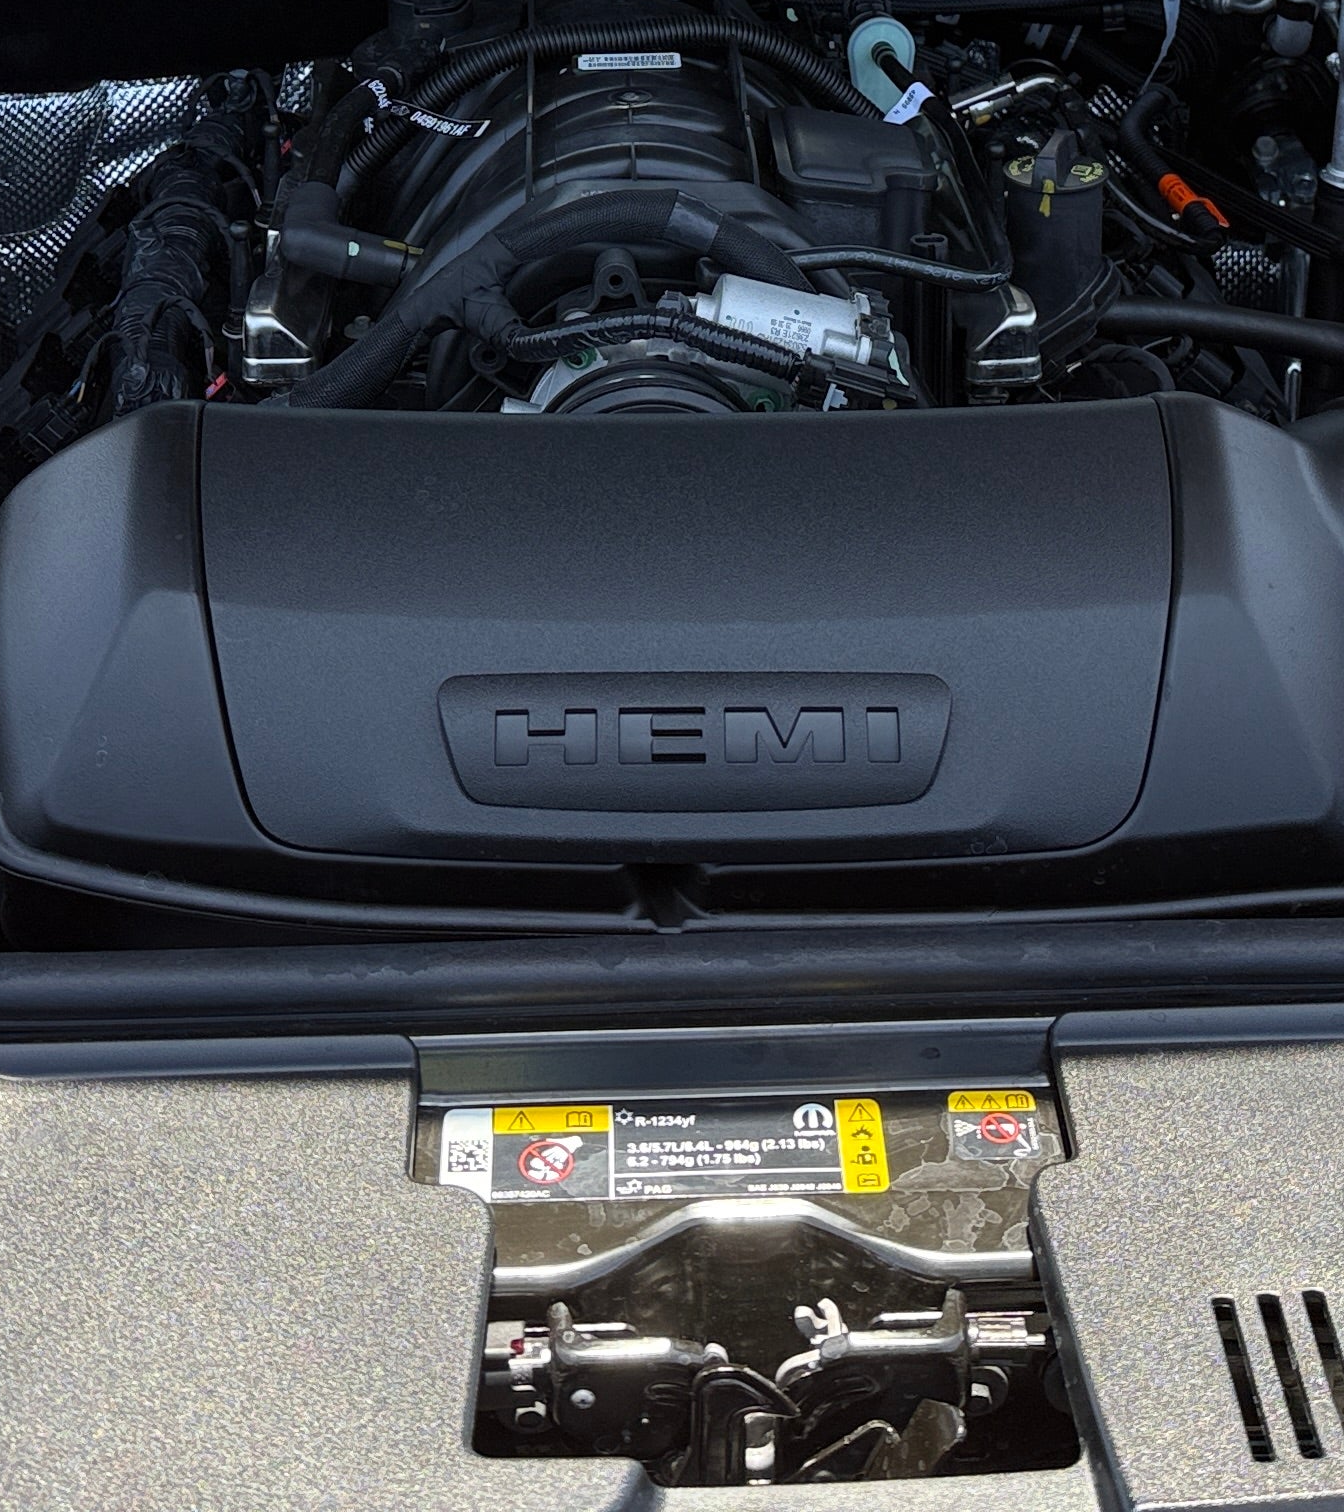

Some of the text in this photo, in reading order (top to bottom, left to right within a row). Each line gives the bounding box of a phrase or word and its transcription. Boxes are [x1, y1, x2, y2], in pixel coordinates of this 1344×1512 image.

[494, 706, 901, 766] HEMI
[634, 1114, 696, 1128] R-1234yf
[761, 1138, 796, 1152] (2.13
[797, 1137, 826, 1151] lbs)
[659, 1154, 695, 1168] 794g
[696, 1153, 732, 1167] (1.75
[733, 1152, 762, 1166] lbs)
[643, 1184, 673, 1194] PAG
